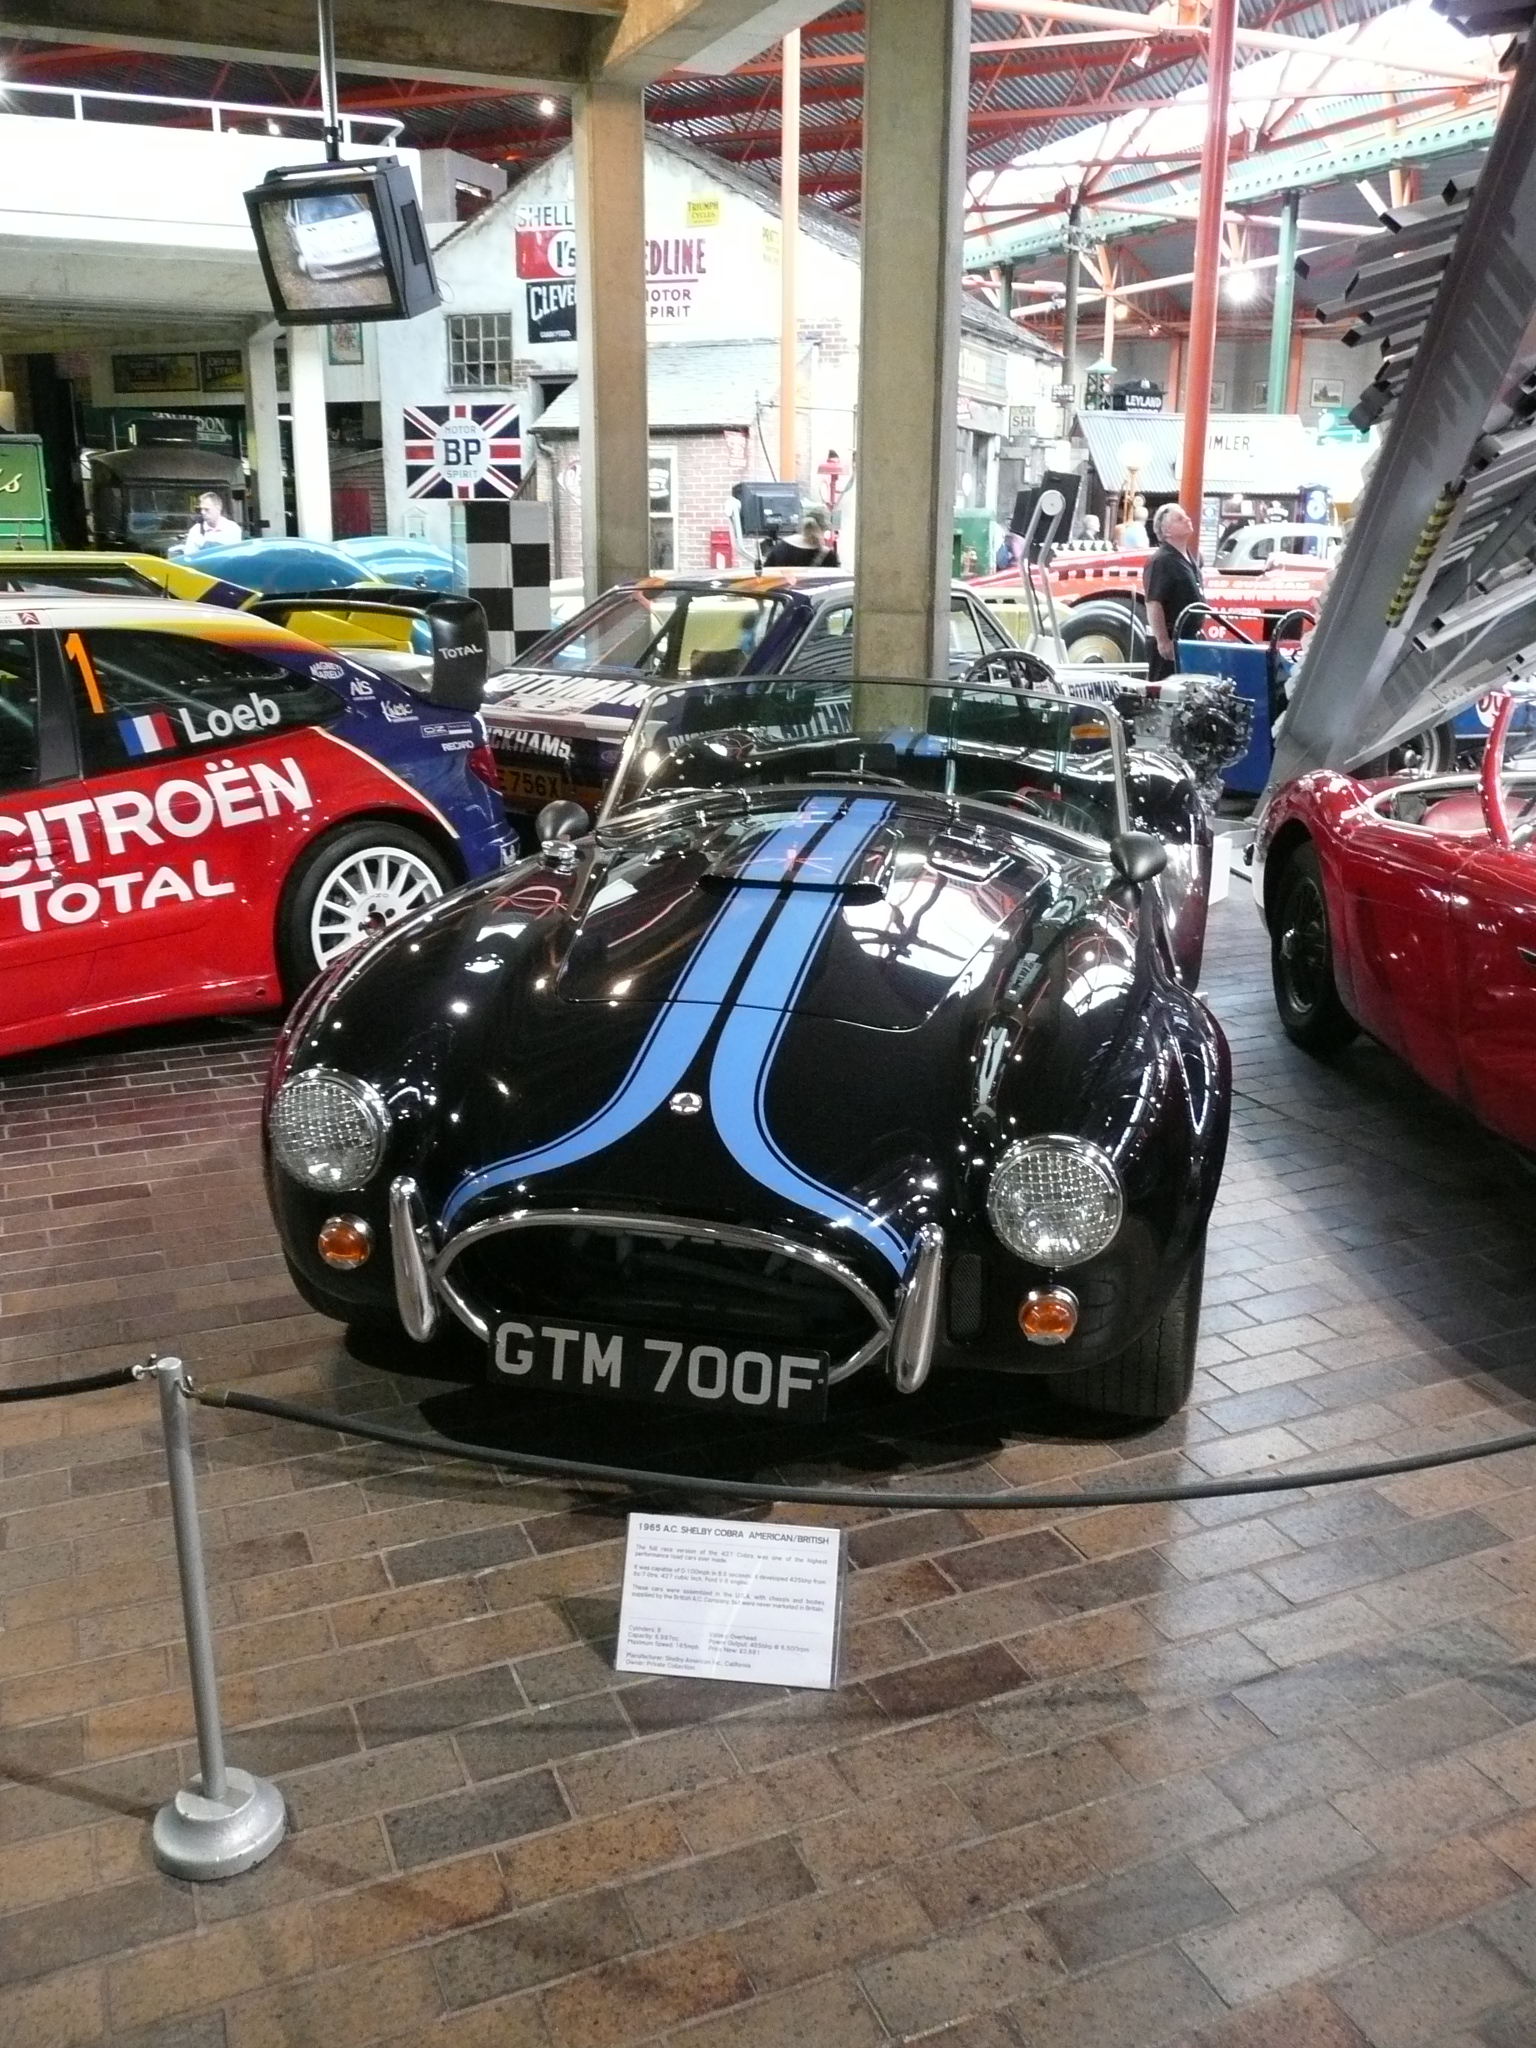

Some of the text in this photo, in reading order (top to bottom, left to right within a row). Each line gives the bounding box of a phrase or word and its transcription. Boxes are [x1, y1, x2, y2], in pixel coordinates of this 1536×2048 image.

[687, 201, 719, 212] TRIUMPH
[692, 211, 716, 219] CYCLES
[518, 205, 573, 227] SHELL
[647, 305, 691, 318] PIRIT
[1125, 394, 1162, 408] LEYLAND
[444, 425, 477, 434] MOTOR
[446, 469, 478, 479] SPIRIT
[438, 642, 484, 660] TOTAL
[64, 632, 105, 713] 1
[1068, 680, 1120, 702] ROTHMANS
[178, 692, 281, 744] Loeb
[487, 727, 573, 760] CKHAMS
[509, 771, 561, 798] 756X
[0, 757, 313, 882] CITROËN
[0, 859, 236, 932] TOTAL
[495, 1322, 820, 1409] GTM 700F
[639, 1523, 829, 1545] 1965 A.C. SHELBY COBRA AMERICAN/BRITISH
[634, 1551, 669, 1560] performance
[635, 1543, 646, 1551] The
[676, 1547, 697, 1555] version
[807, 1557, 828, 1566] highest
[651, 1565, 673, 1573] capable
[673, 1566, 680, 1574] of
[758, 1574, 789, 1583] developed
[631, 1591, 655, 1599] supplied
[772, 1602, 799, 1610] marketed
[632, 1583, 649, 1591] These
[682, 1588, 713, 1596] assembled
[768, 1595, 790, 1603] chassis
[805, 1598, 825, 1606] bodies
[627, 1638, 654, 1646] Maximum
[729, 1633, 757, 1641] Overhead
[646, 1660, 666, 1668] Private
[666, 1662, 695, 1670] Collection
[724, 1660, 752, 1669] California
